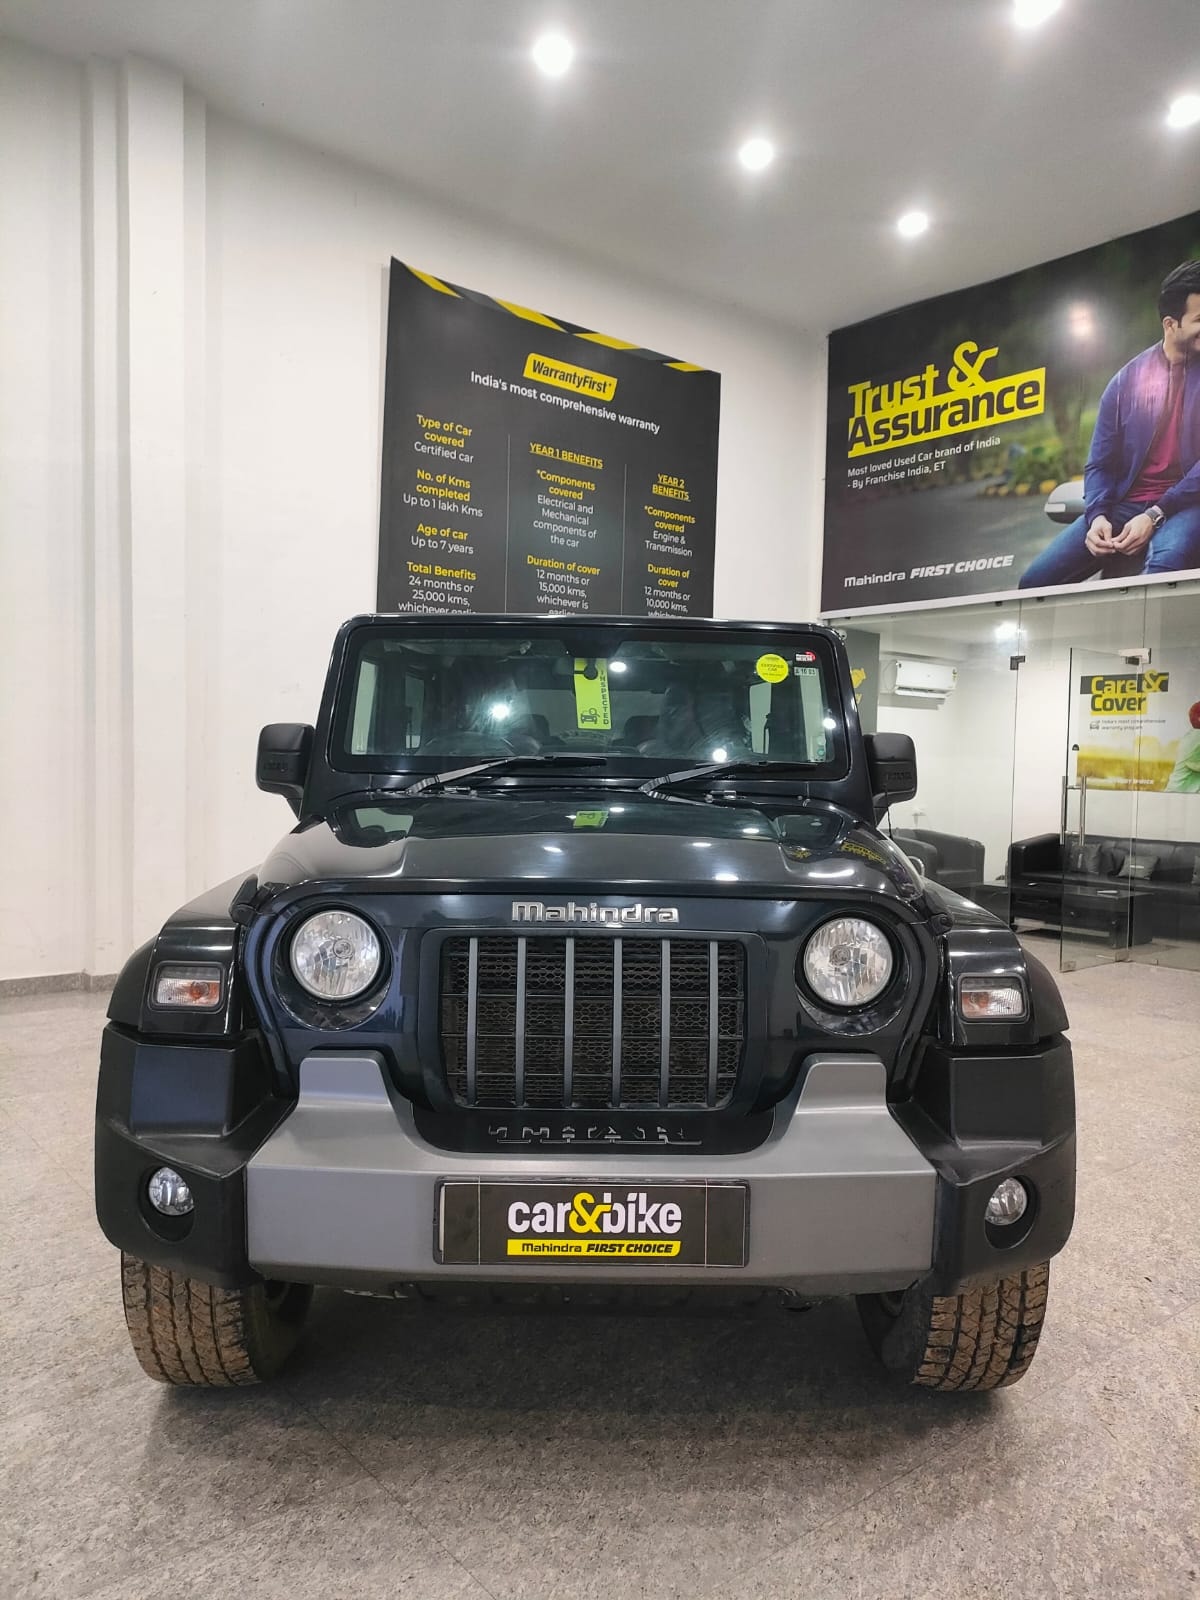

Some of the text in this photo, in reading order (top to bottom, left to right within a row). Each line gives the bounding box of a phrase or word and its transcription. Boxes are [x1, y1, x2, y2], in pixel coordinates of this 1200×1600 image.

[848, 340, 999, 418] Trust &
[471, 371, 660, 435] India's most comprehensive warranty
[850, 380, 1040, 449] Assurance
[416, 414, 472, 436] Type of Car
[424, 431, 464, 448] covered
[414, 441, 474, 463] Certified car
[530, 442, 603, 469] YEAR 1 BENEFITS
[848, 435, 1001, 478] Most loved Used Car brand of India
[416, 469, 471, 489] No. of Kms
[658, 473, 685, 489] YEAR 2
[852, 478, 864, 490] By
[865, 470, 905, 486] Franchise
[907, 463, 932, 477] India,
[934, 460, 946, 471] ET
[416, 484, 470, 502] completed
[549, 486, 583, 500] covered
[652, 484, 690, 501] BENEFITS
[403, 493, 417, 506] Up
[420, 497, 430, 508] to
[438, 500, 458, 512] lakh
[461, 504, 483, 517] Kms
[537, 494, 594, 515] Electrical and
[541, 508, 589, 525] Mechanical
[417, 523, 468, 540] Age of car
[533, 520, 597, 539] components of
[654, 520, 685, 533] covered
[411, 535, 474, 554] Up to 7 years
[550, 535, 579, 548] the car
[653, 530, 686, 545] Engine &
[645, 540, 692, 557] Transmission
[406, 561, 477, 581] Total Benefits
[527, 555, 601, 576] Duration of cover
[647, 563, 690, 578] Duration of
[844, 555, 1014, 587] Mahindra FIRST CHOICE
[408, 575, 474, 593] 24 months or
[536, 568, 590, 586] 12 months or
[658, 578, 679, 588] cover
[412, 589, 471, 607] 25,000 kms,
[539, 581, 587, 598] 15,000 kms,
[644, 585, 651, 596] 12
[653, 589, 681, 600] months
[398, 601, 449, 614] whichever
[537, 594, 589, 610] whichever is
[646, 598, 689, 613] 10,000 kms,
[1091, 669, 1169, 694] Care &
[600, 670, 609, 725] INSPECTED
[1091, 694, 1146, 712] Cover
[512, 901, 680, 923] Mahindra
[521, 1243, 673, 1253] Mahindra FIRST CHOICE
